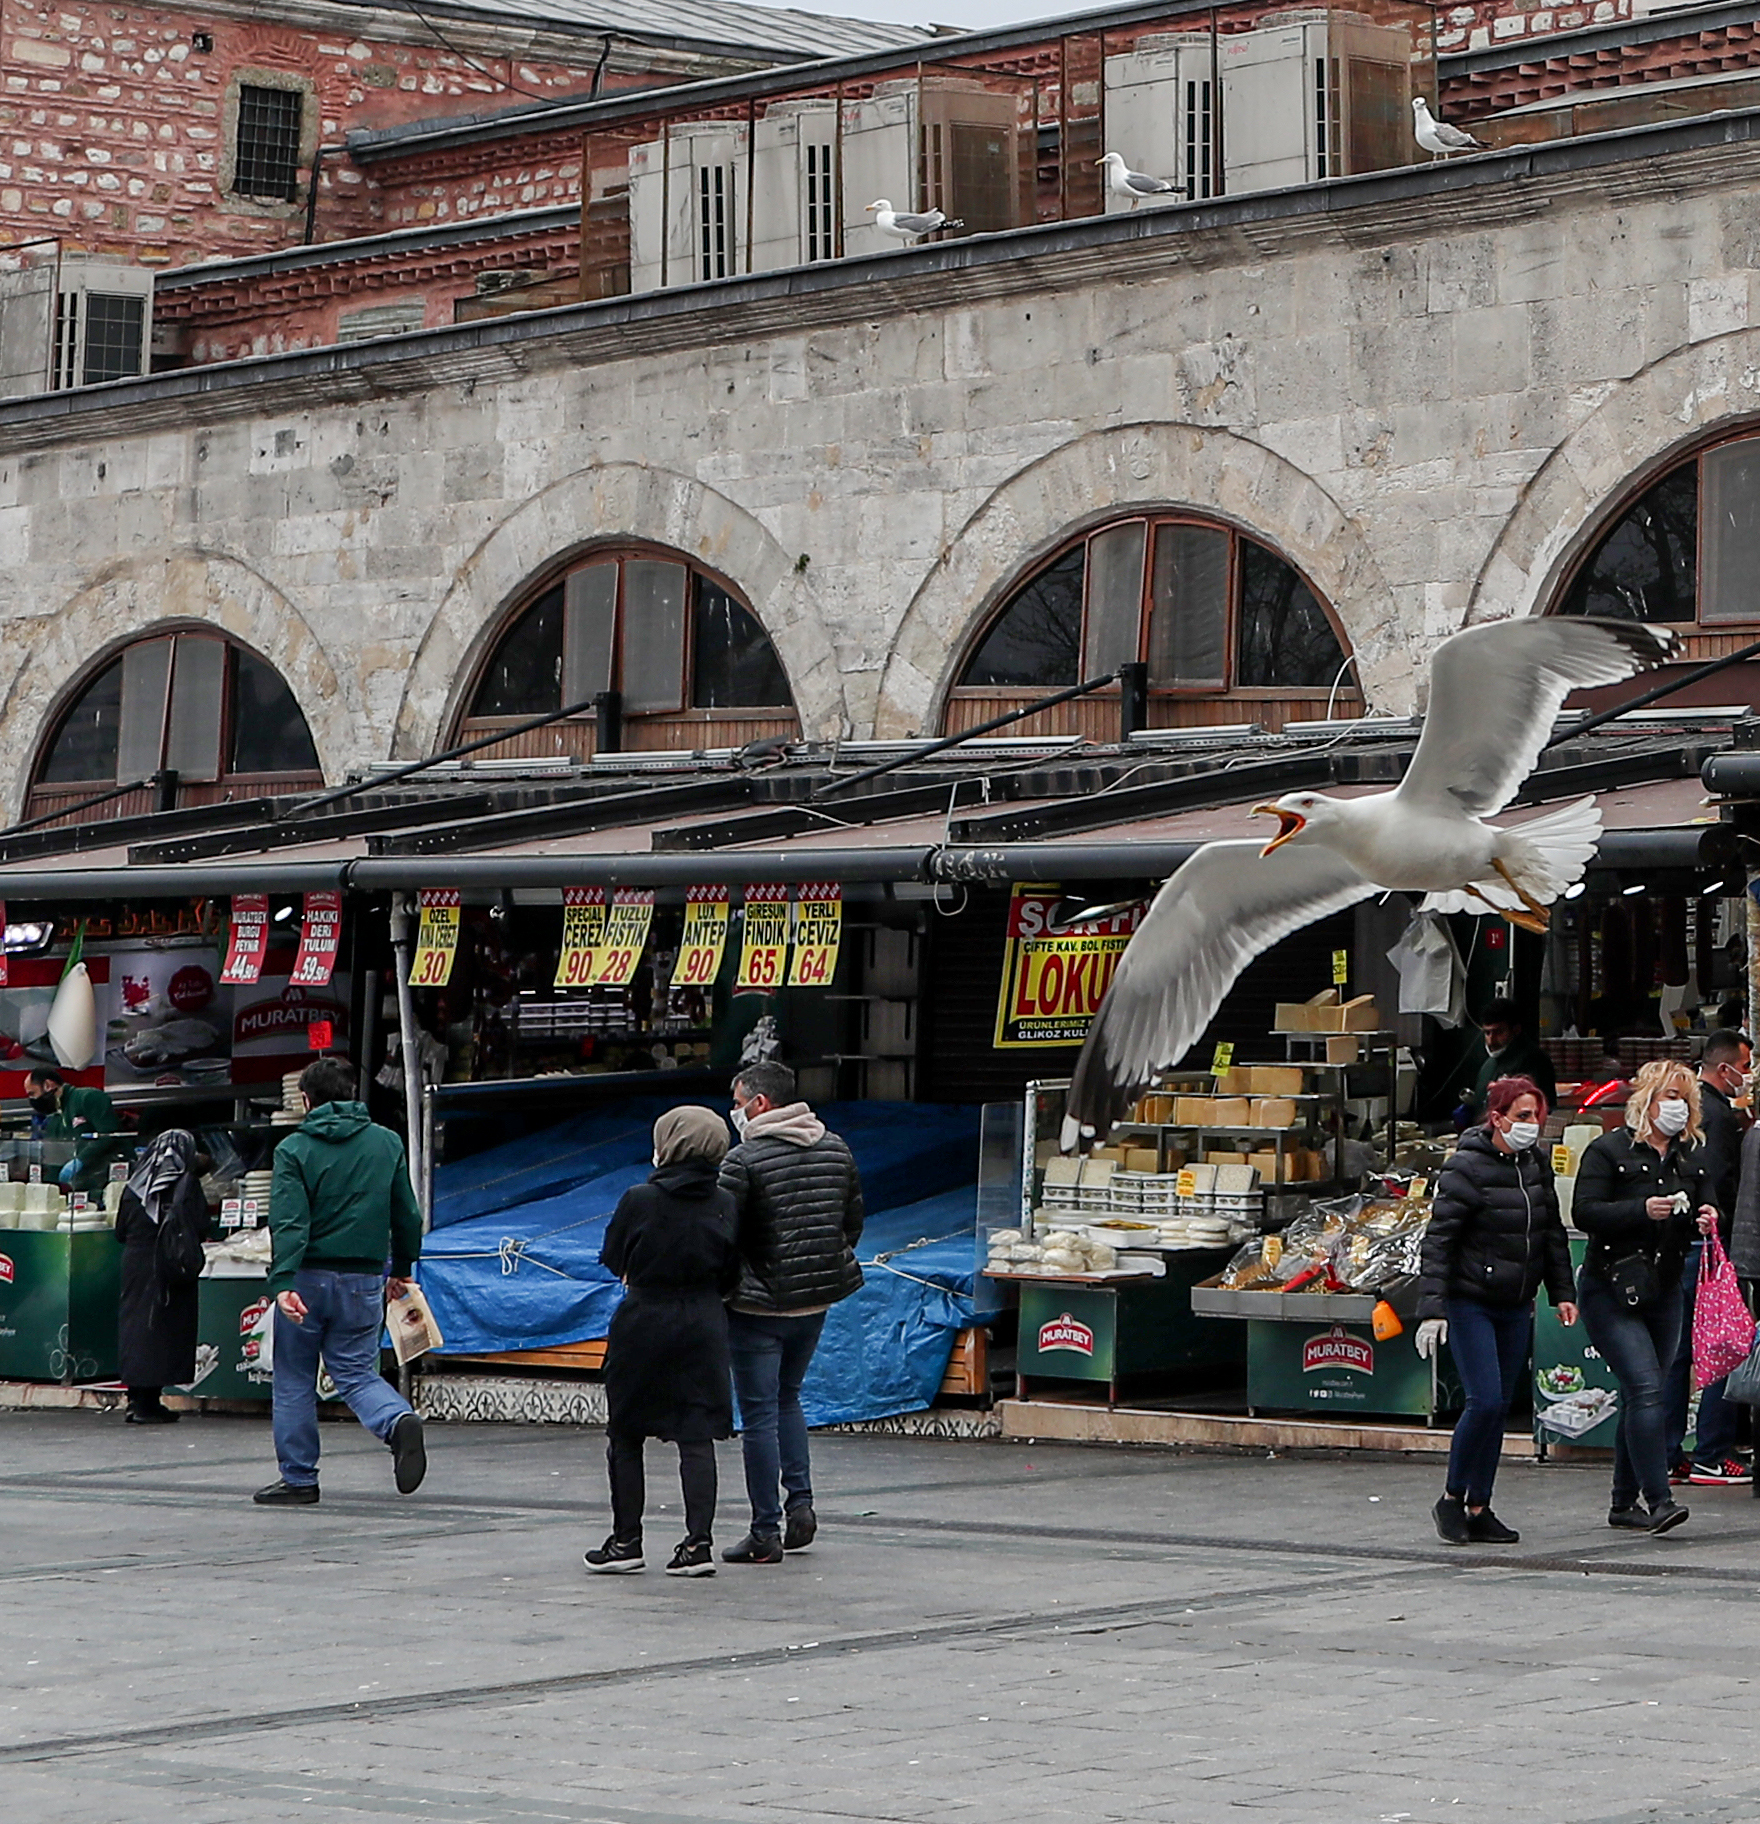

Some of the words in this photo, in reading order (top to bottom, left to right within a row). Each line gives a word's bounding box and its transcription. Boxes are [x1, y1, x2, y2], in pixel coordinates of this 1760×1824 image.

[232, 911, 267, 924] MURATBEY
[613, 906, 650, 921] TUZLU
[303, 938, 336, 952] TULUM
[564, 924, 604, 955] ÇEREZ
[604, 923, 647, 947] FISTIK
[683, 921, 726, 946] ANTEP
[745, 921, 785, 946] FINDIK
[1056, 940, 1079, 952] KAV.
[1081, 939, 1099, 951] BOL
[419, 952, 447, 983] 30
[565, 950, 593, 983] 90
[598, 950, 633, 982] 28
[683, 948, 714, 983] 90
[749, 949, 777, 984] 65
[799, 948, 828, 984] 64
[1016, 953, 1115, 1016] LOKU
[241, 1004, 342, 1033] MURATBEY
[1041, 1328, 1090, 1349] MURATBEY
[1307, 1342, 1369, 1363] MURATBEY
